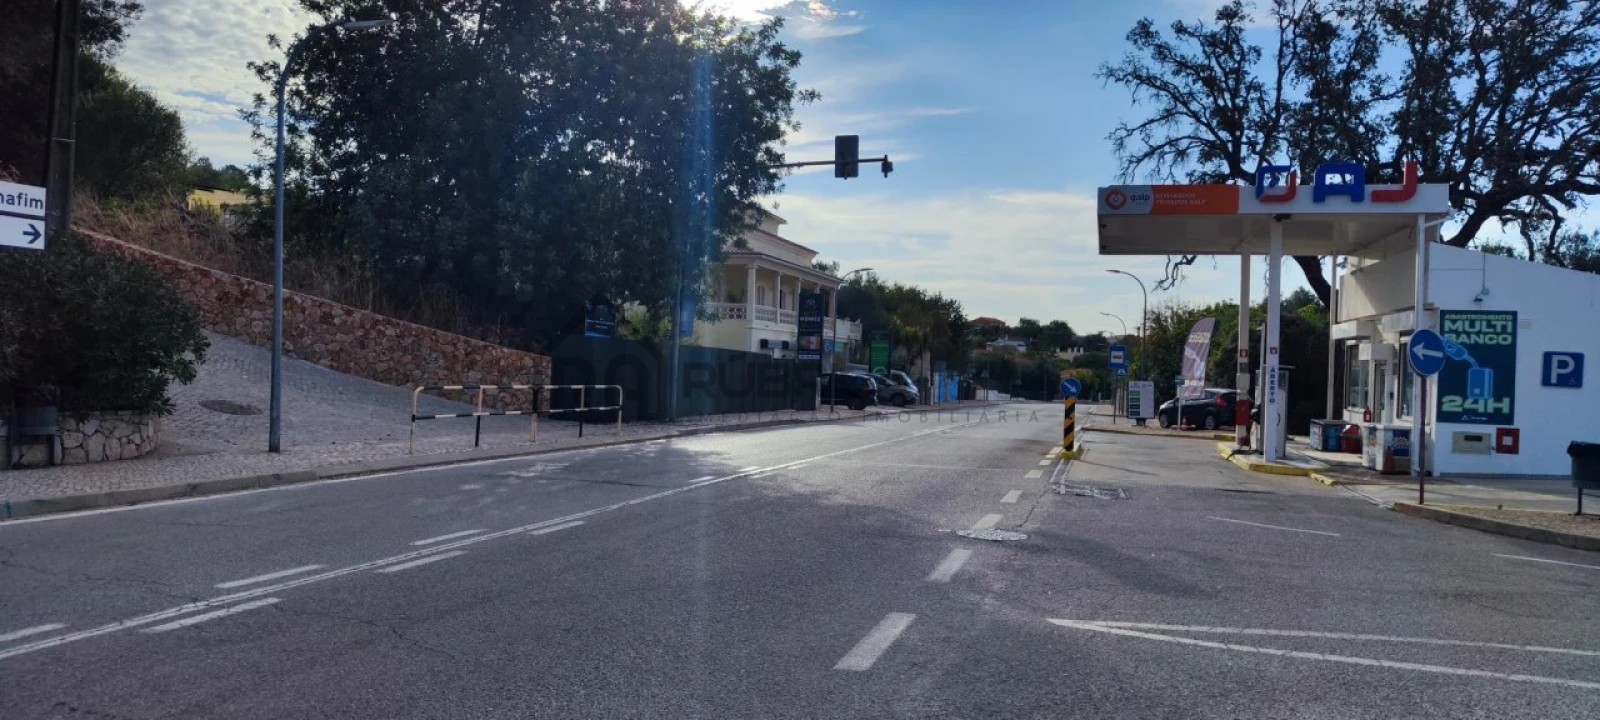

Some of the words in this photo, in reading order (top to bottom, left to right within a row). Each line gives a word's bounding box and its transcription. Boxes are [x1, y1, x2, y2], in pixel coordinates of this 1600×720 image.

[1130, 193, 1151, 203] galp
[1444, 320, 1513, 333] MULTI
[1444, 333, 1512, 345] BANCO
[1550, 354, 1576, 384] P
[1441, 395, 1510, 414] 24H
